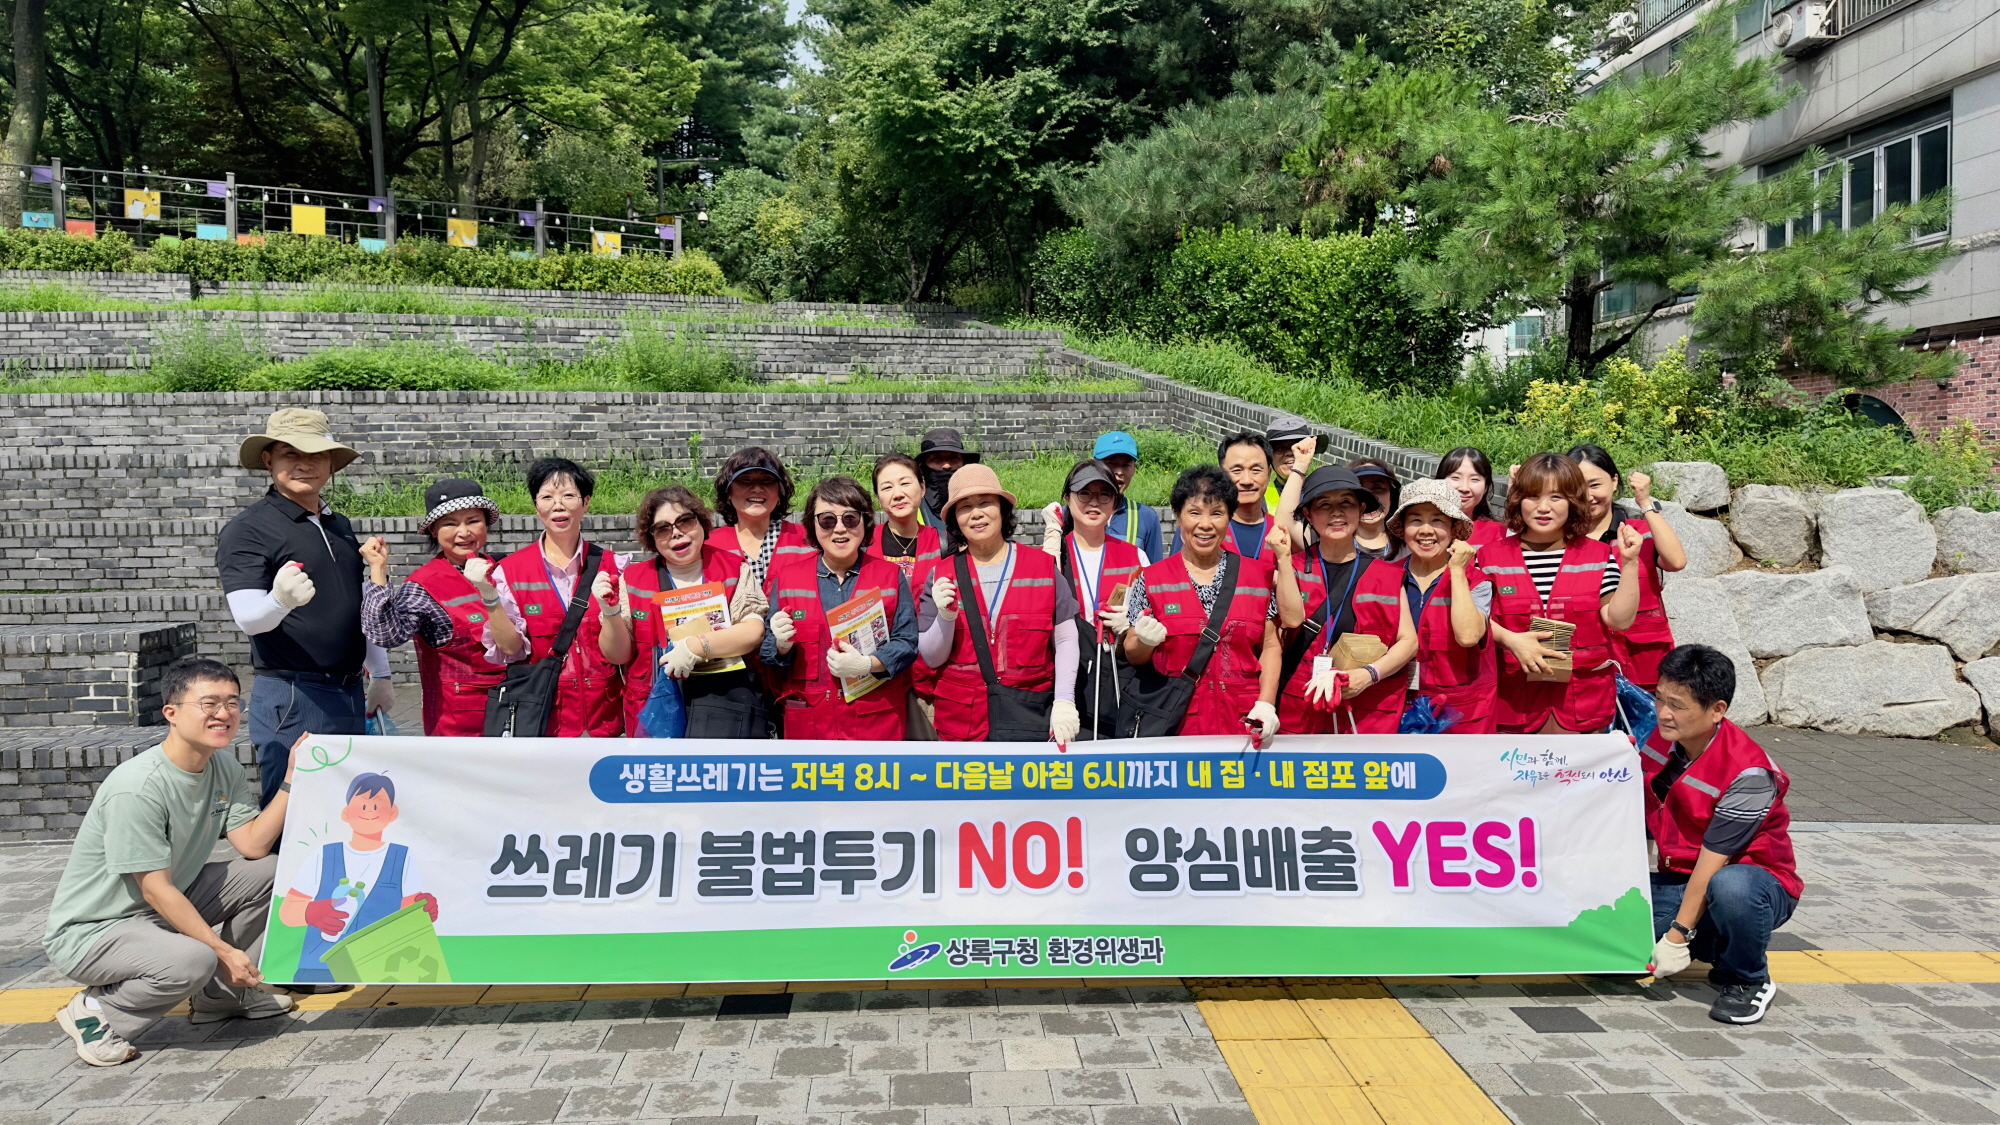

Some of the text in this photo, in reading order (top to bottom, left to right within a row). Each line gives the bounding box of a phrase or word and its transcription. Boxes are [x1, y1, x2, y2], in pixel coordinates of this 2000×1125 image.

[1500, 748, 1539, 770] 시민과
[619, 762, 784, 794] 생활쓰레기는
[791, 762, 845, 792] 저녁
[854, 762, 900, 791] 8시
[935, 761, 1015, 791] 다음날
[1021, 760, 1073, 790] 아침
[1082, 760, 1178, 789] 6시까지
[1186, 760, 1212, 789] 내
[1219, 760, 1245, 789] 집
[1269, 760, 1295, 788] 내
[1302, 760, 1357, 789] 점포
[1363, 761, 1417, 790] 앞에
[1554, 769, 1595, 786] 혁신도시
[1599, 768, 1633, 782] 안산
[486, 816, 1538, 899] 쓰레기 불법투기 NO! 양심배출 YES!
[946, 937, 1164, 966] 상록구청 환경위생과
